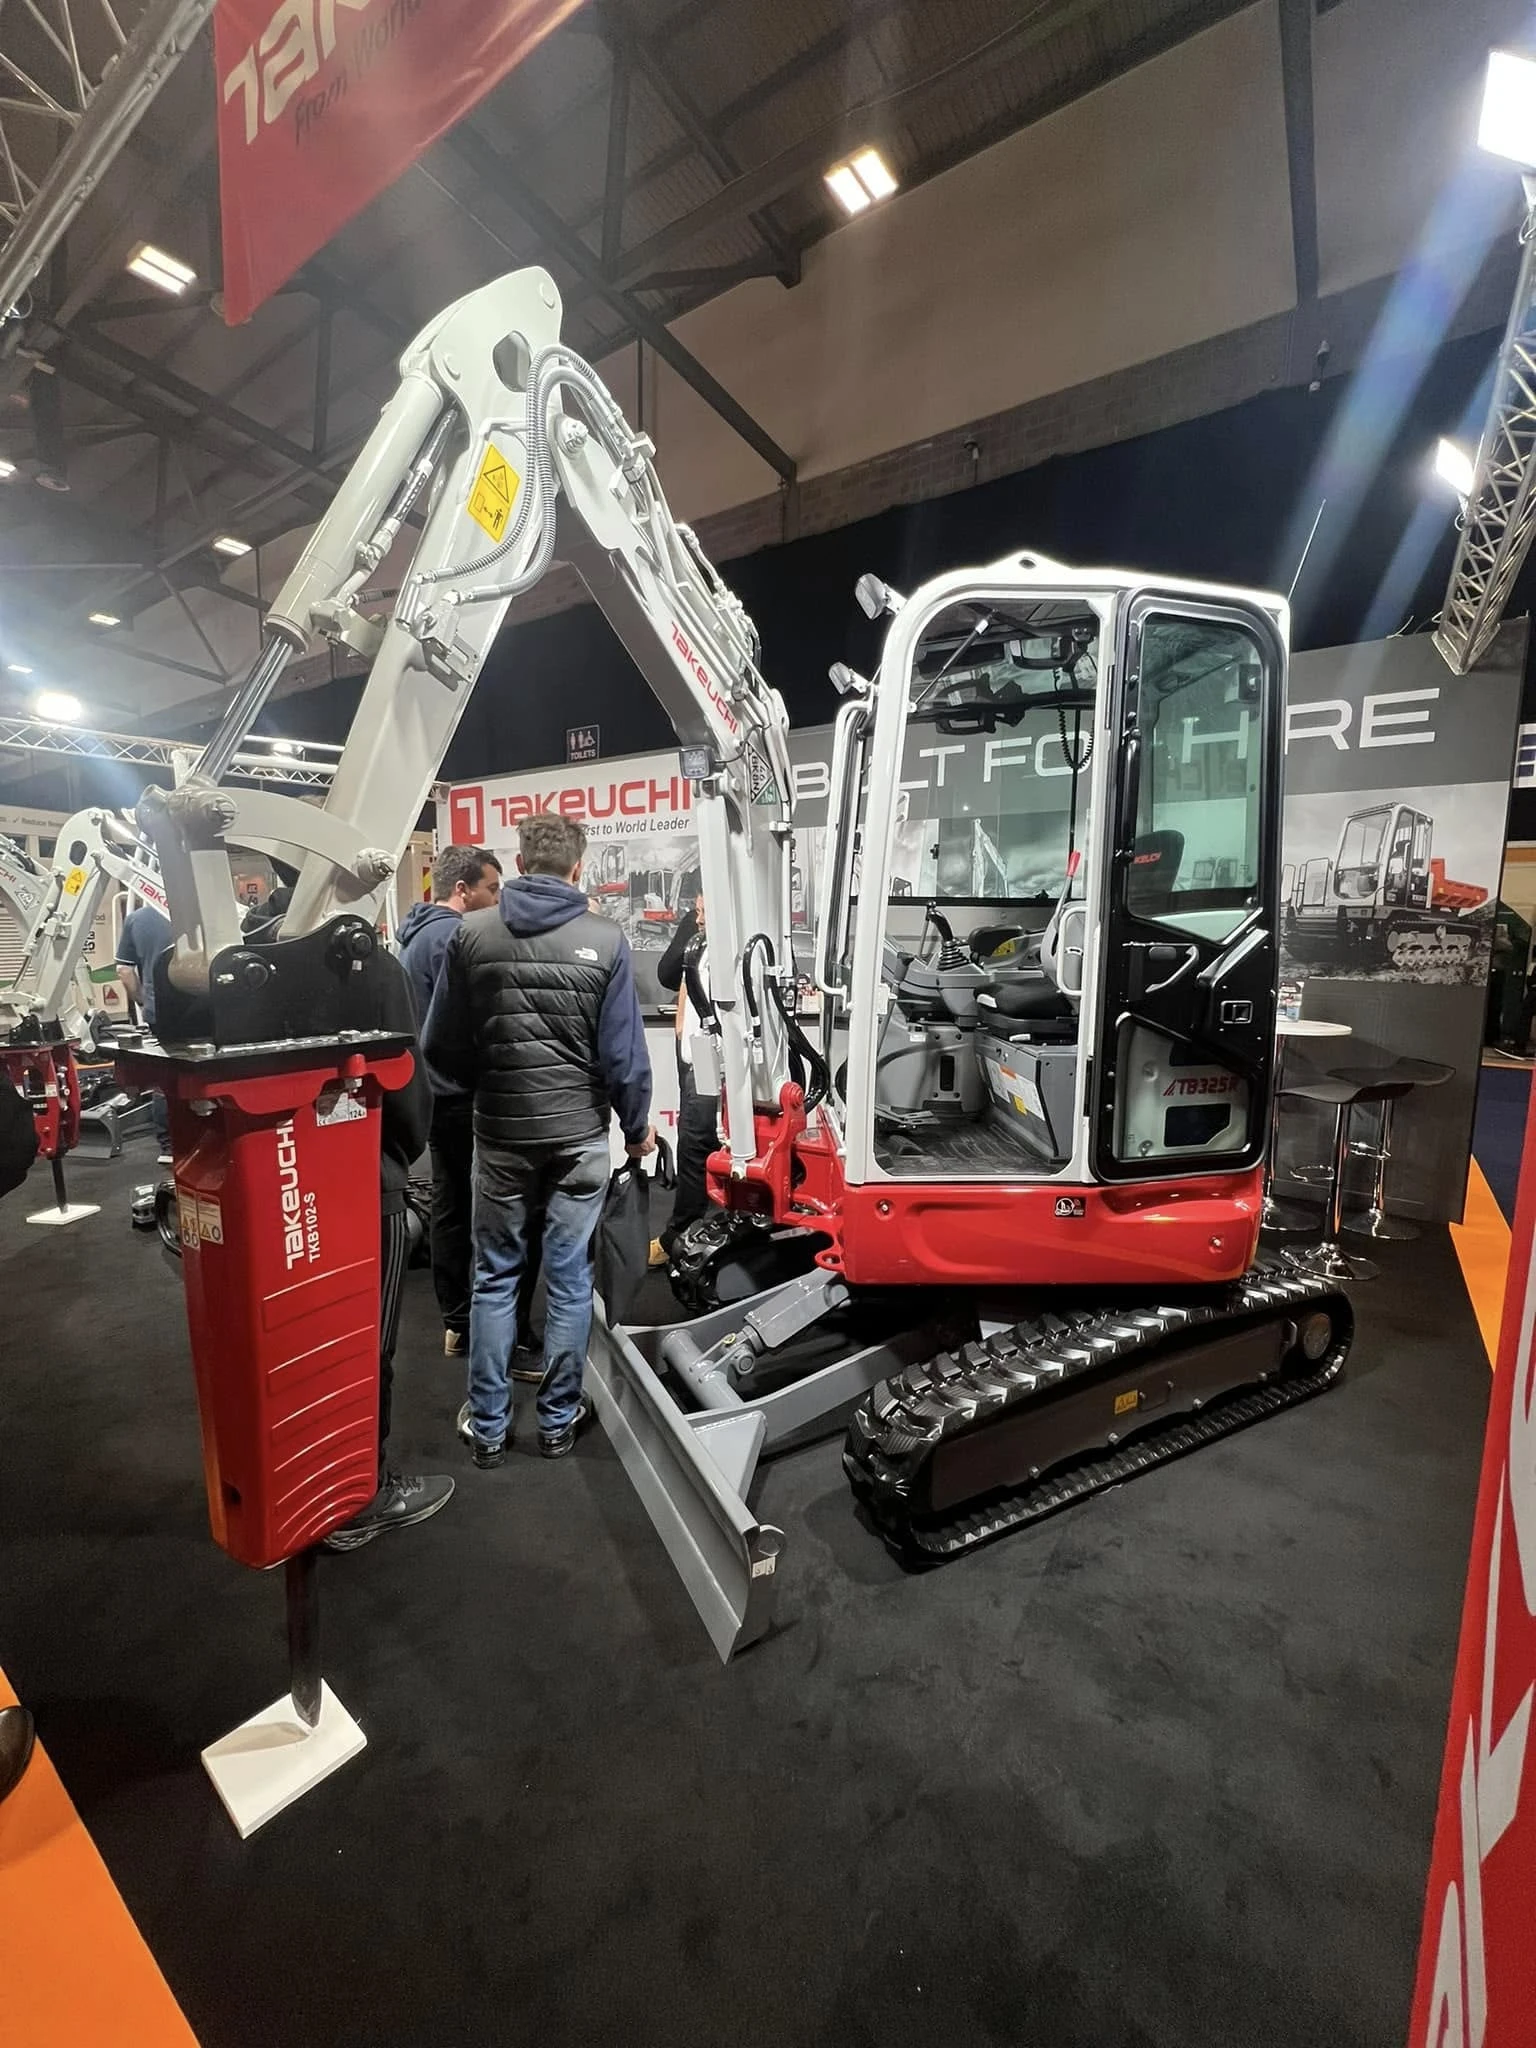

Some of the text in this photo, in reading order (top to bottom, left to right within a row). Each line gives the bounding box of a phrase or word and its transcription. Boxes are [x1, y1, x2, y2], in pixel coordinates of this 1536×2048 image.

[570, 749, 597, 760] TOILETS
[602, 824, 613, 835] to
[615, 820, 647, 834] World
[649, 817, 690, 831] Leader
[303, 1191, 321, 1263] TKB102-S
